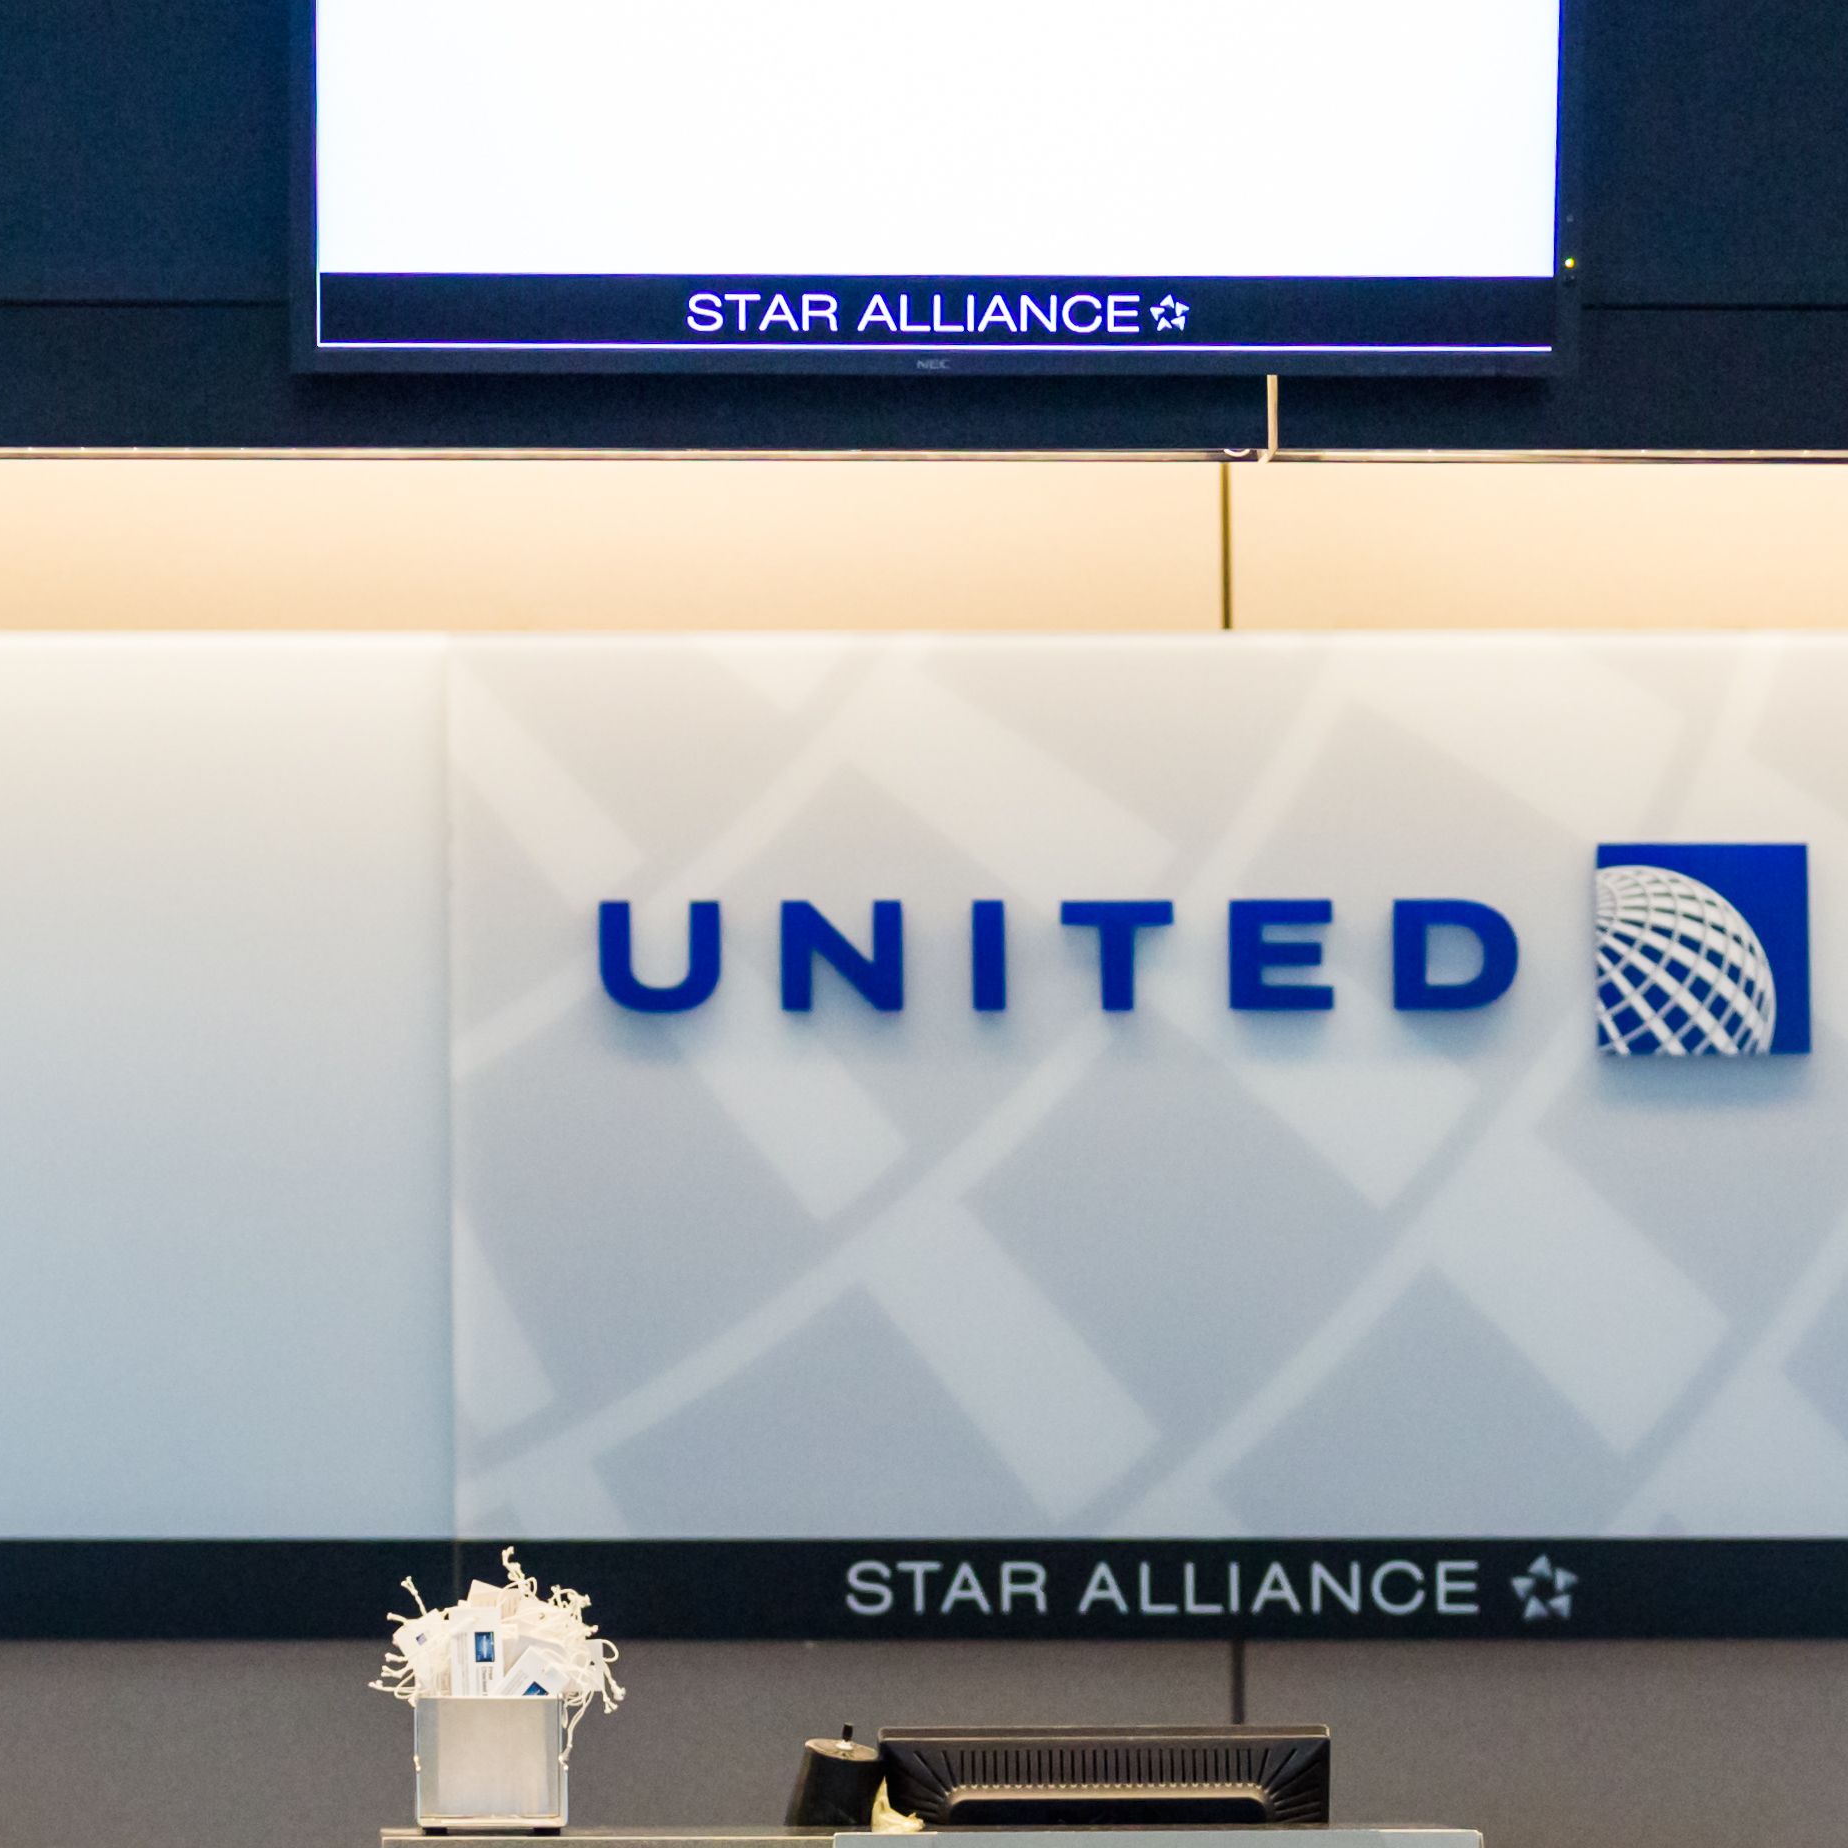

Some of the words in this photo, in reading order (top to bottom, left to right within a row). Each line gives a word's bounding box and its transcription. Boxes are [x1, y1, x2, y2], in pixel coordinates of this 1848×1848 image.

[686, 292, 839, 333] STAR
[856, 292, 1141, 333] ALLIANCE
[916, 359, 951, 370] NEC
[598, 898, 1521, 1014] UNITED
[845, 1559, 1048, 1616] STAR
[1077, 1559, 1480, 1616] ALLIANCE
